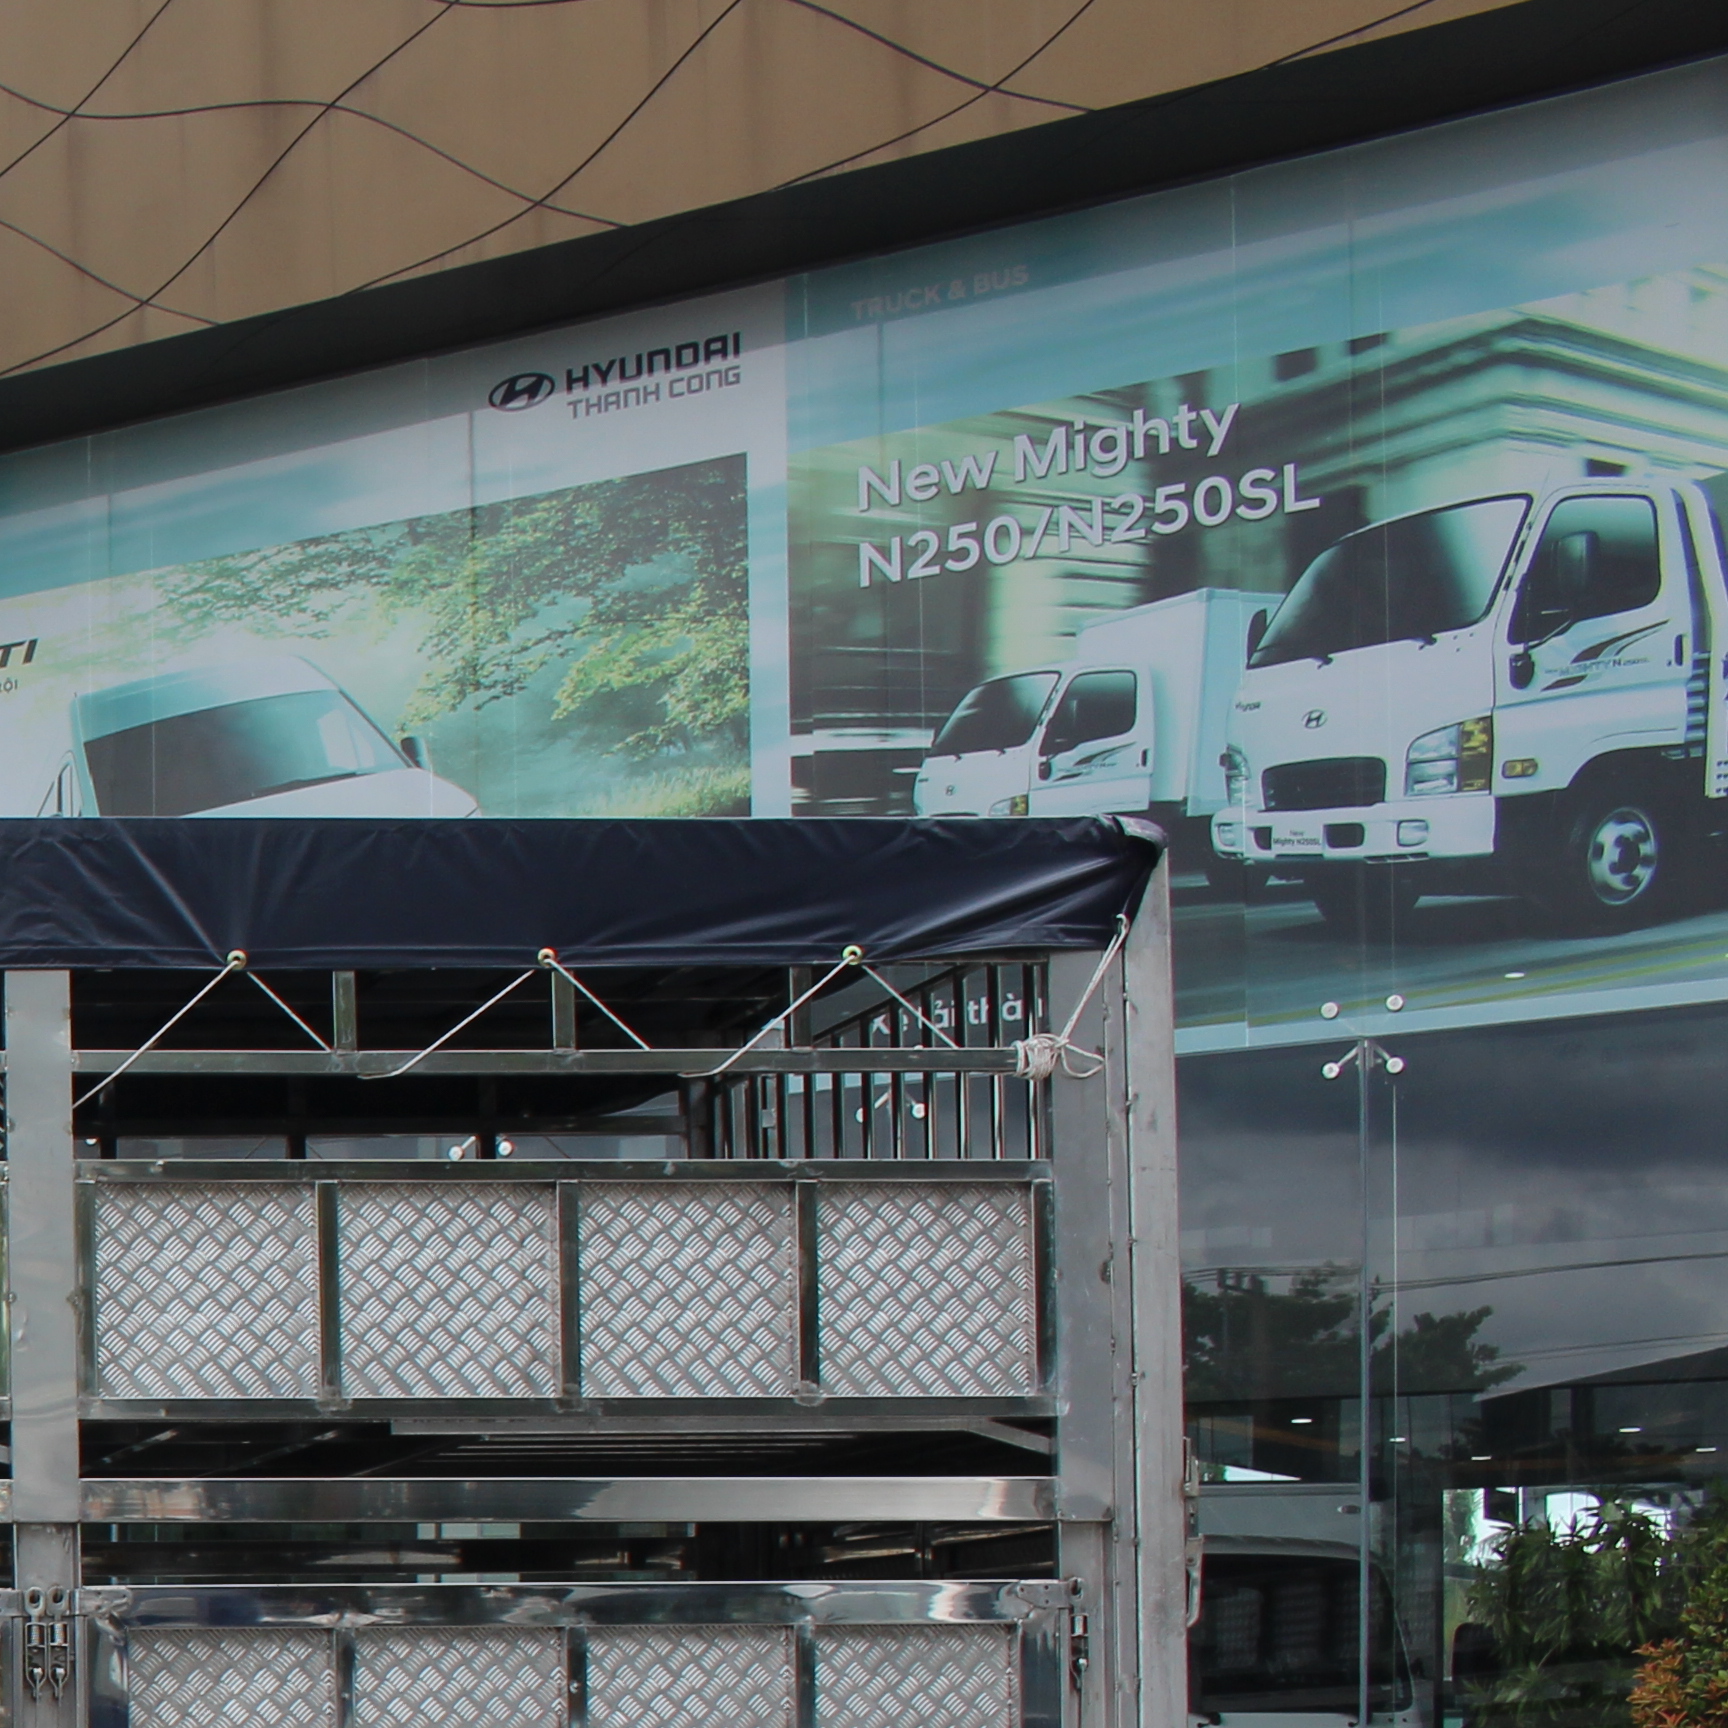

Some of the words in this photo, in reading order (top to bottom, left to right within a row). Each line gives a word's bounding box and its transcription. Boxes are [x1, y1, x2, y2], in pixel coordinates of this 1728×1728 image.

[851, 283, 941, 320] TRUCK
[948, 279, 966, 300] &
[974, 264, 1029, 295] BUS
[565, 331, 741, 395] HYUNDAI
[566, 382, 660, 419] THANH
[668, 365, 741, 399] CONG
[857, 449, 998, 512] New
[1013, 402, 1240, 484] Mighty
[857, 462, 1321, 589] N250/N250SL
